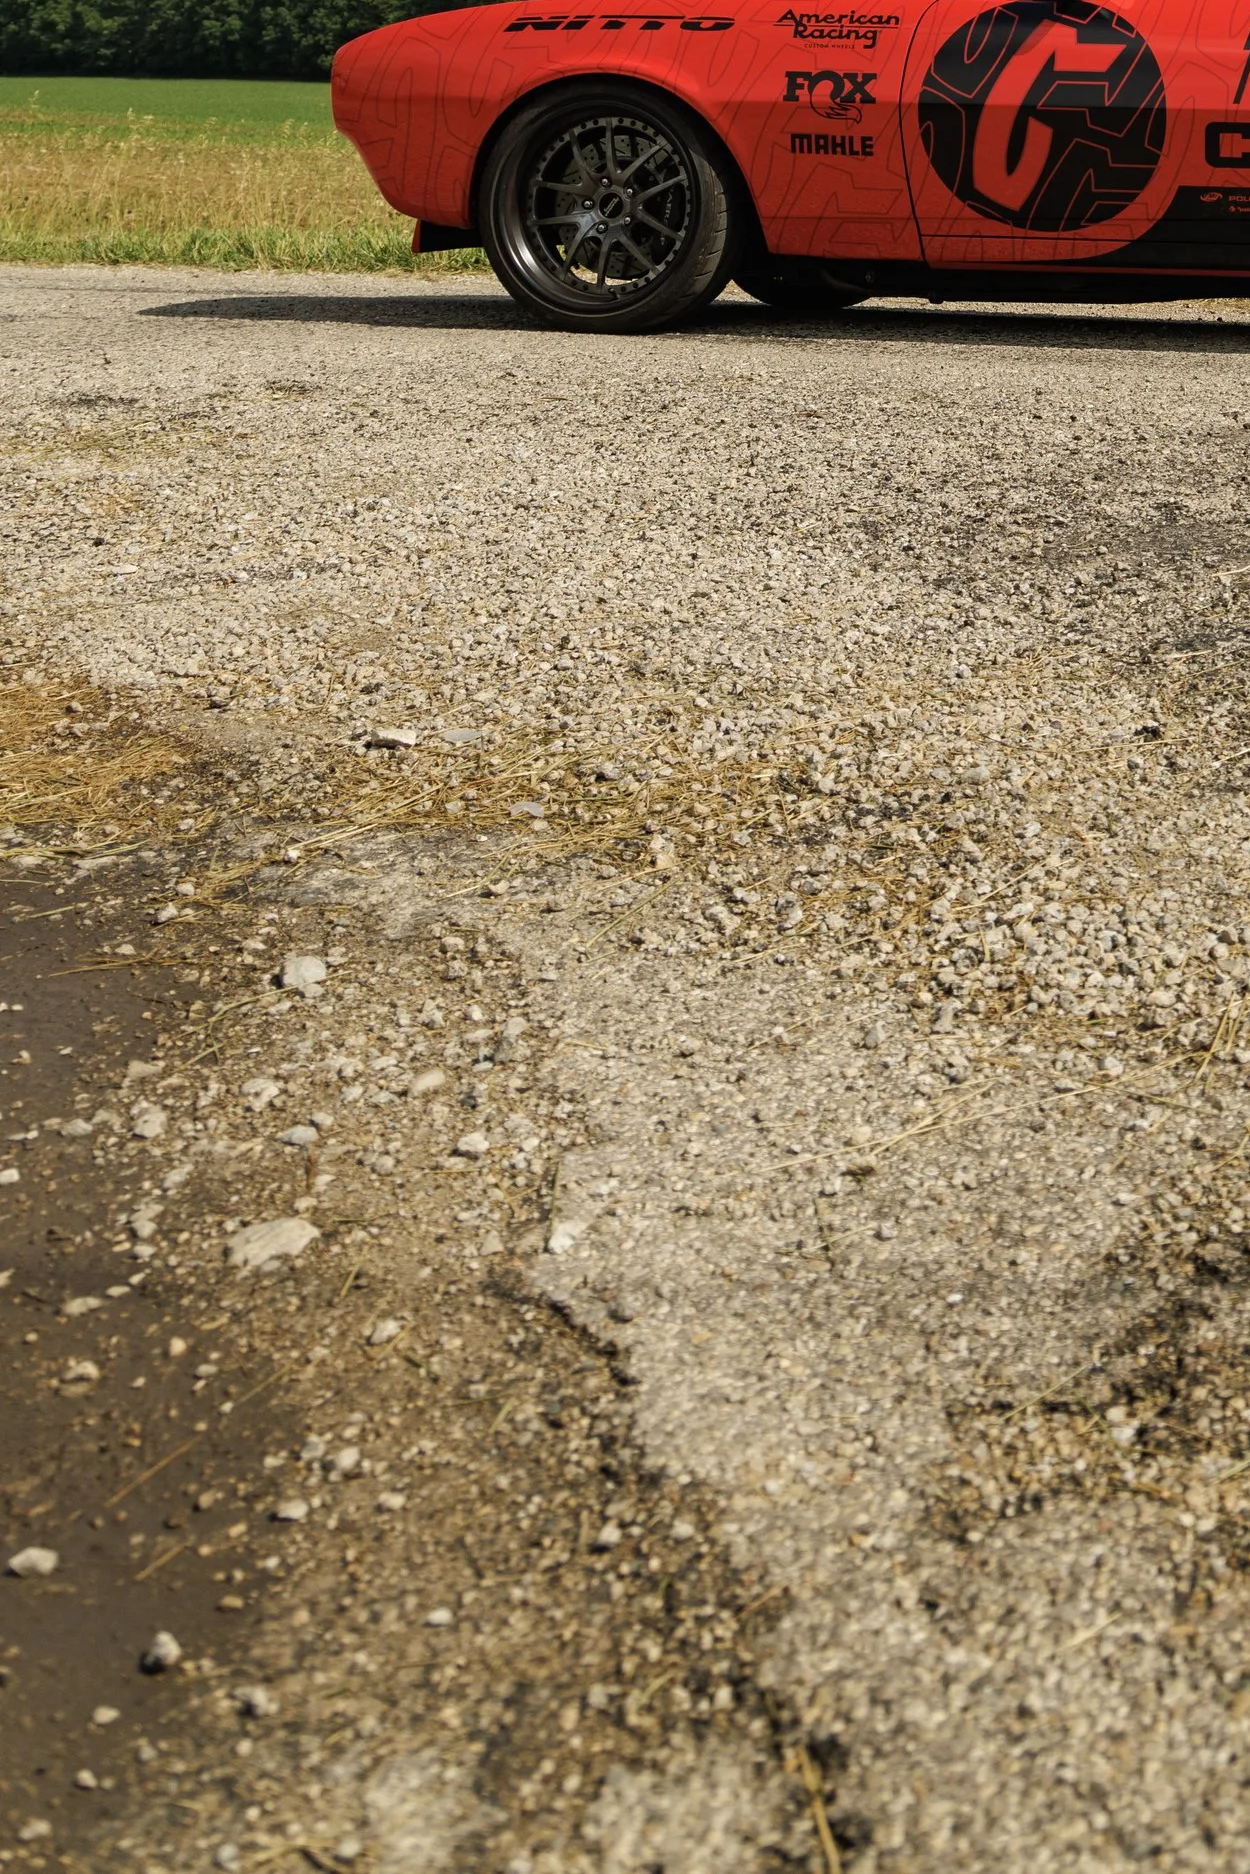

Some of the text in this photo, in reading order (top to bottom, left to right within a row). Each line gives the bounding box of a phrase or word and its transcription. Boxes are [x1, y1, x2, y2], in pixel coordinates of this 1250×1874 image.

[503, 15, 735, 32] NITTO
[776, 9, 900, 25] American
[793, 23, 878, 49] Racing
[783, 70, 877, 108] FOX
[790, 133, 874, 157] MAHLE
